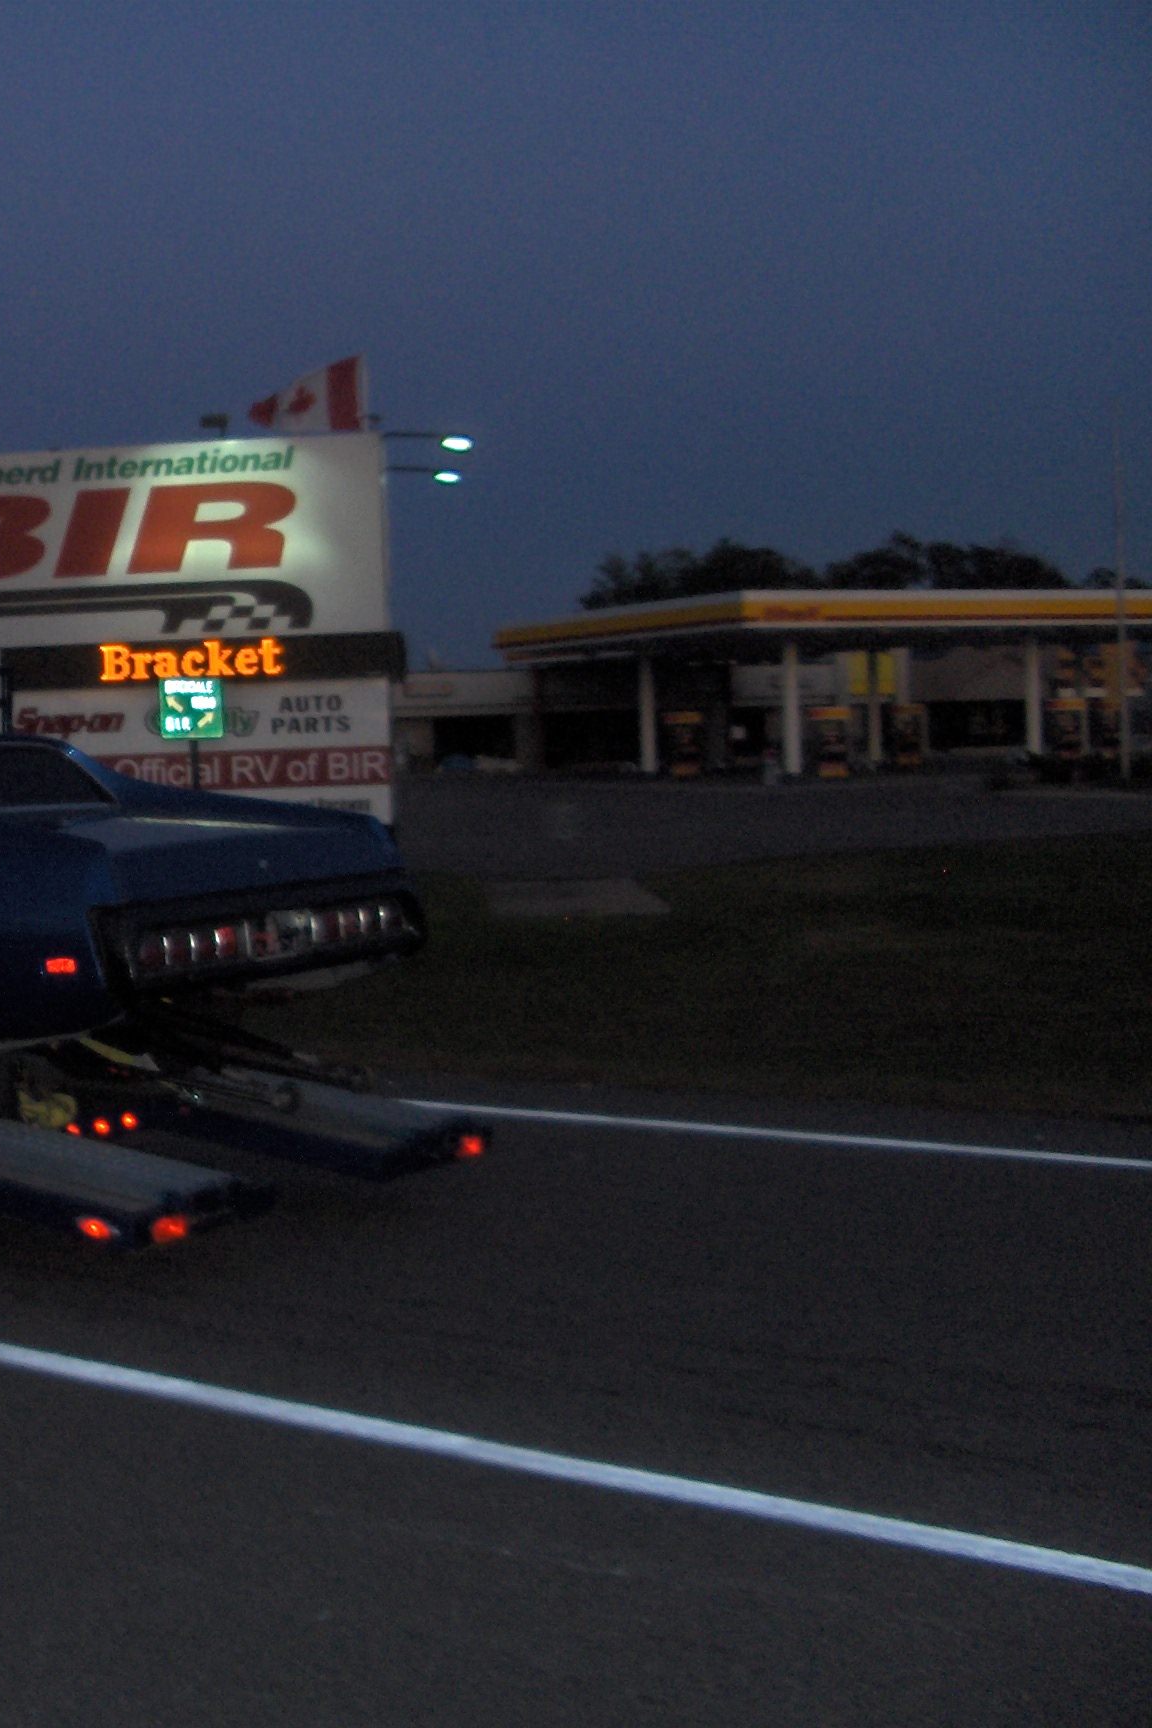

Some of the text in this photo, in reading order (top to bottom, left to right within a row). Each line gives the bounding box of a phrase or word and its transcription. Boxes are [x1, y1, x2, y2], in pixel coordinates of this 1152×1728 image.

[72, 446, 295, 482] International
[98, 637, 282, 682] Bracket
[279, 694, 343, 713] AUTO
[13, 706, 126, 739] Snap-on
[270, 715, 352, 735] PARTS
[230, 754, 279, 784] RV
[286, 752, 318, 782] of
[327, 750, 386, 781] BIR
